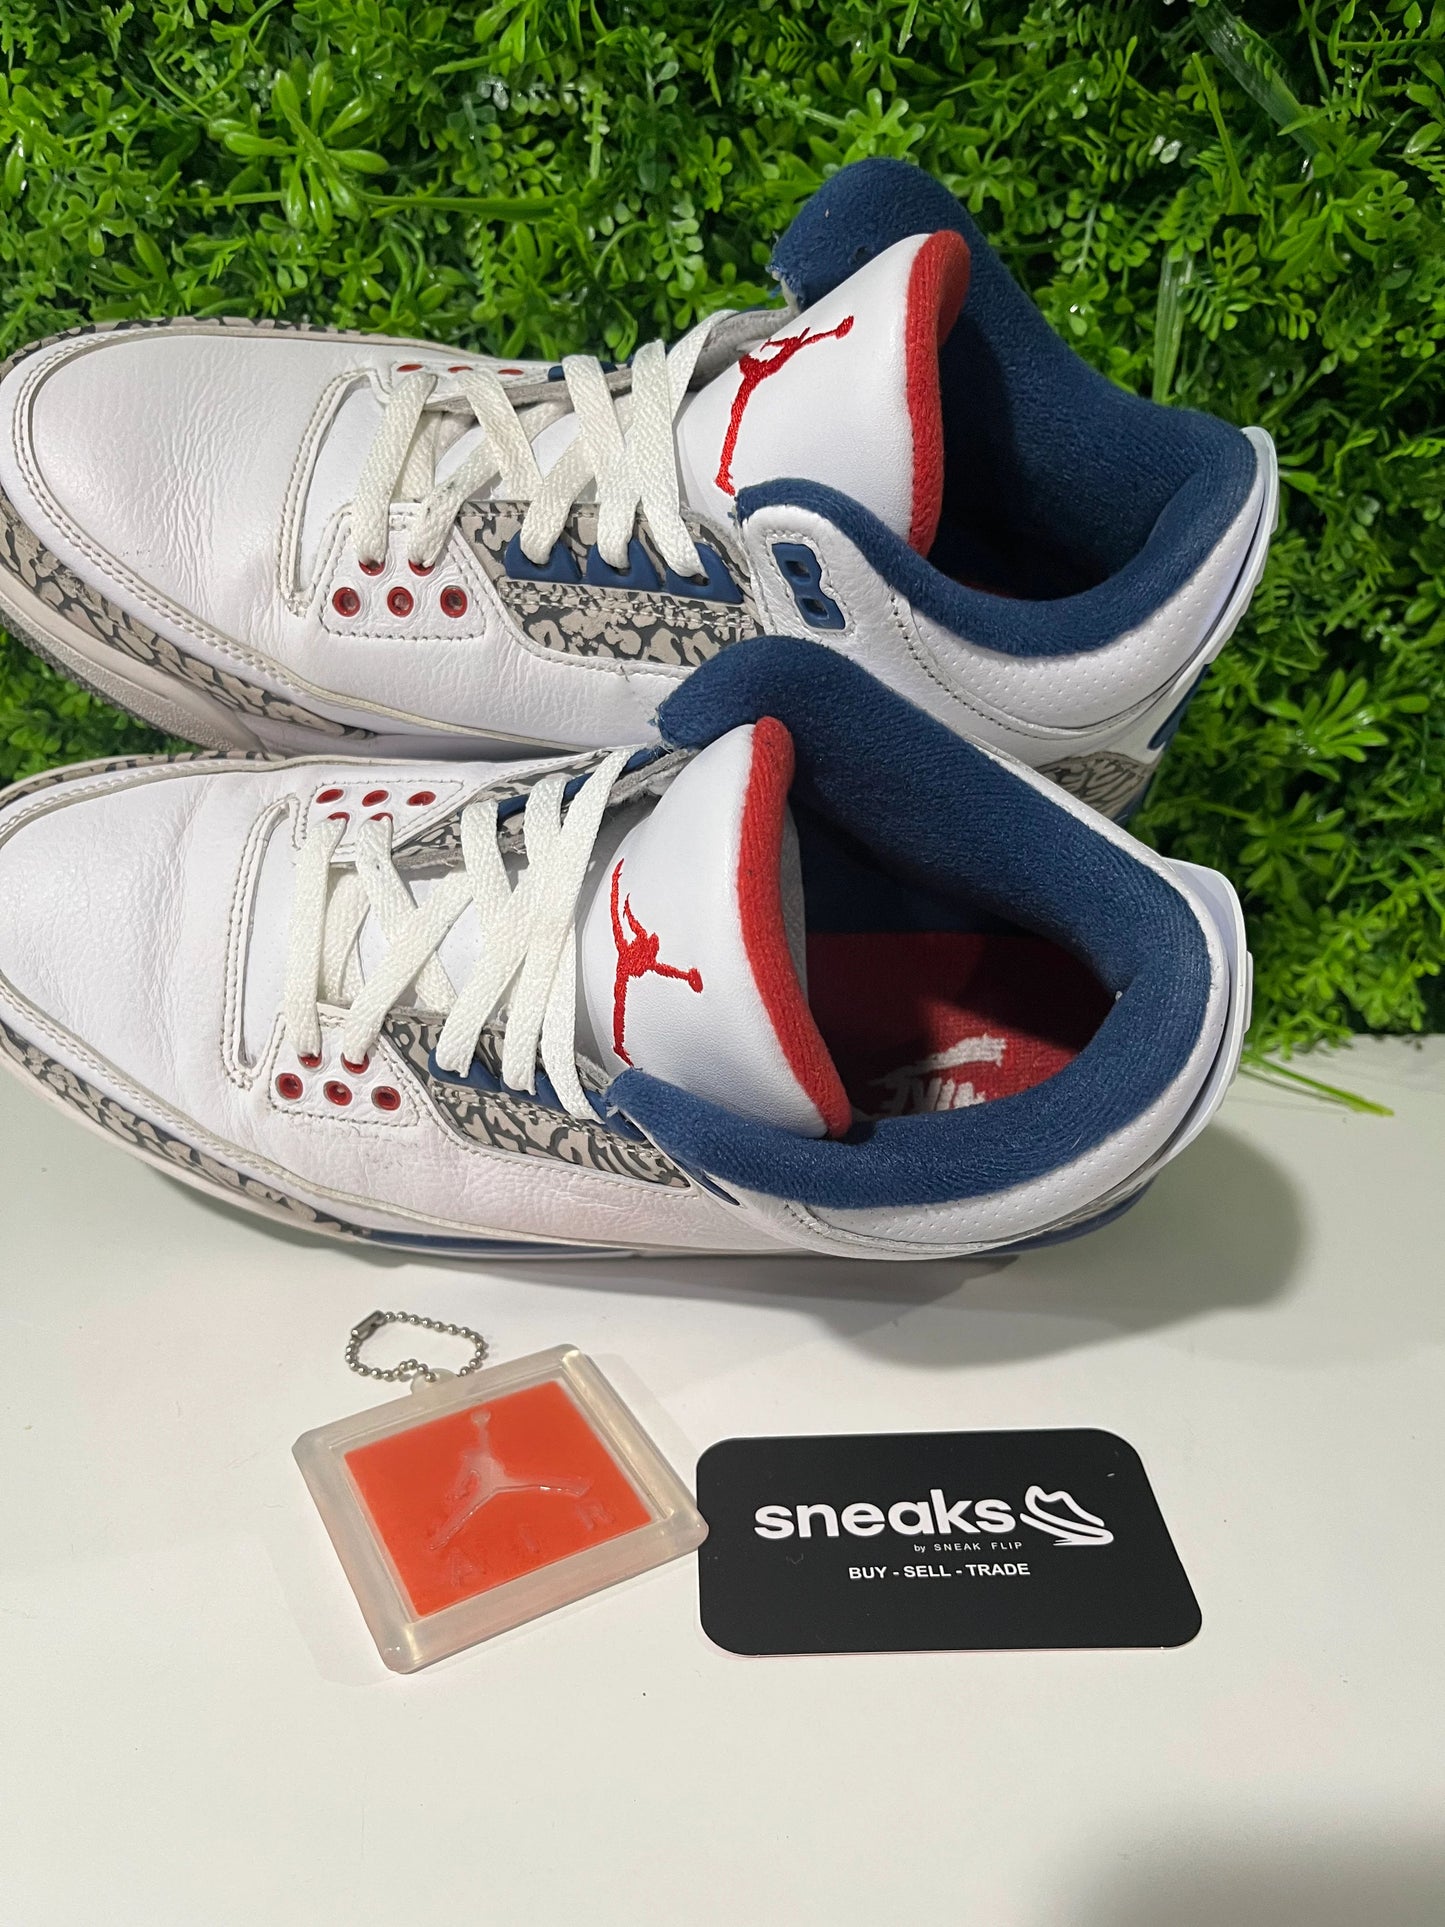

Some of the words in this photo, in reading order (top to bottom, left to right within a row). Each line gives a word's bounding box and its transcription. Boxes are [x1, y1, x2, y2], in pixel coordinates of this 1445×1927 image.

[754, 1488, 1017, 1540] sneaks
[913, 1544, 926, 1554] by
[933, 1542, 982, 1552] SNEAK
[990, 1541, 1023, 1551] FLIP
[848, 1566, 887, 1580] BUY
[903, 1564, 952, 1579] SELL
[964, 1562, 1031, 1577] TRADE
